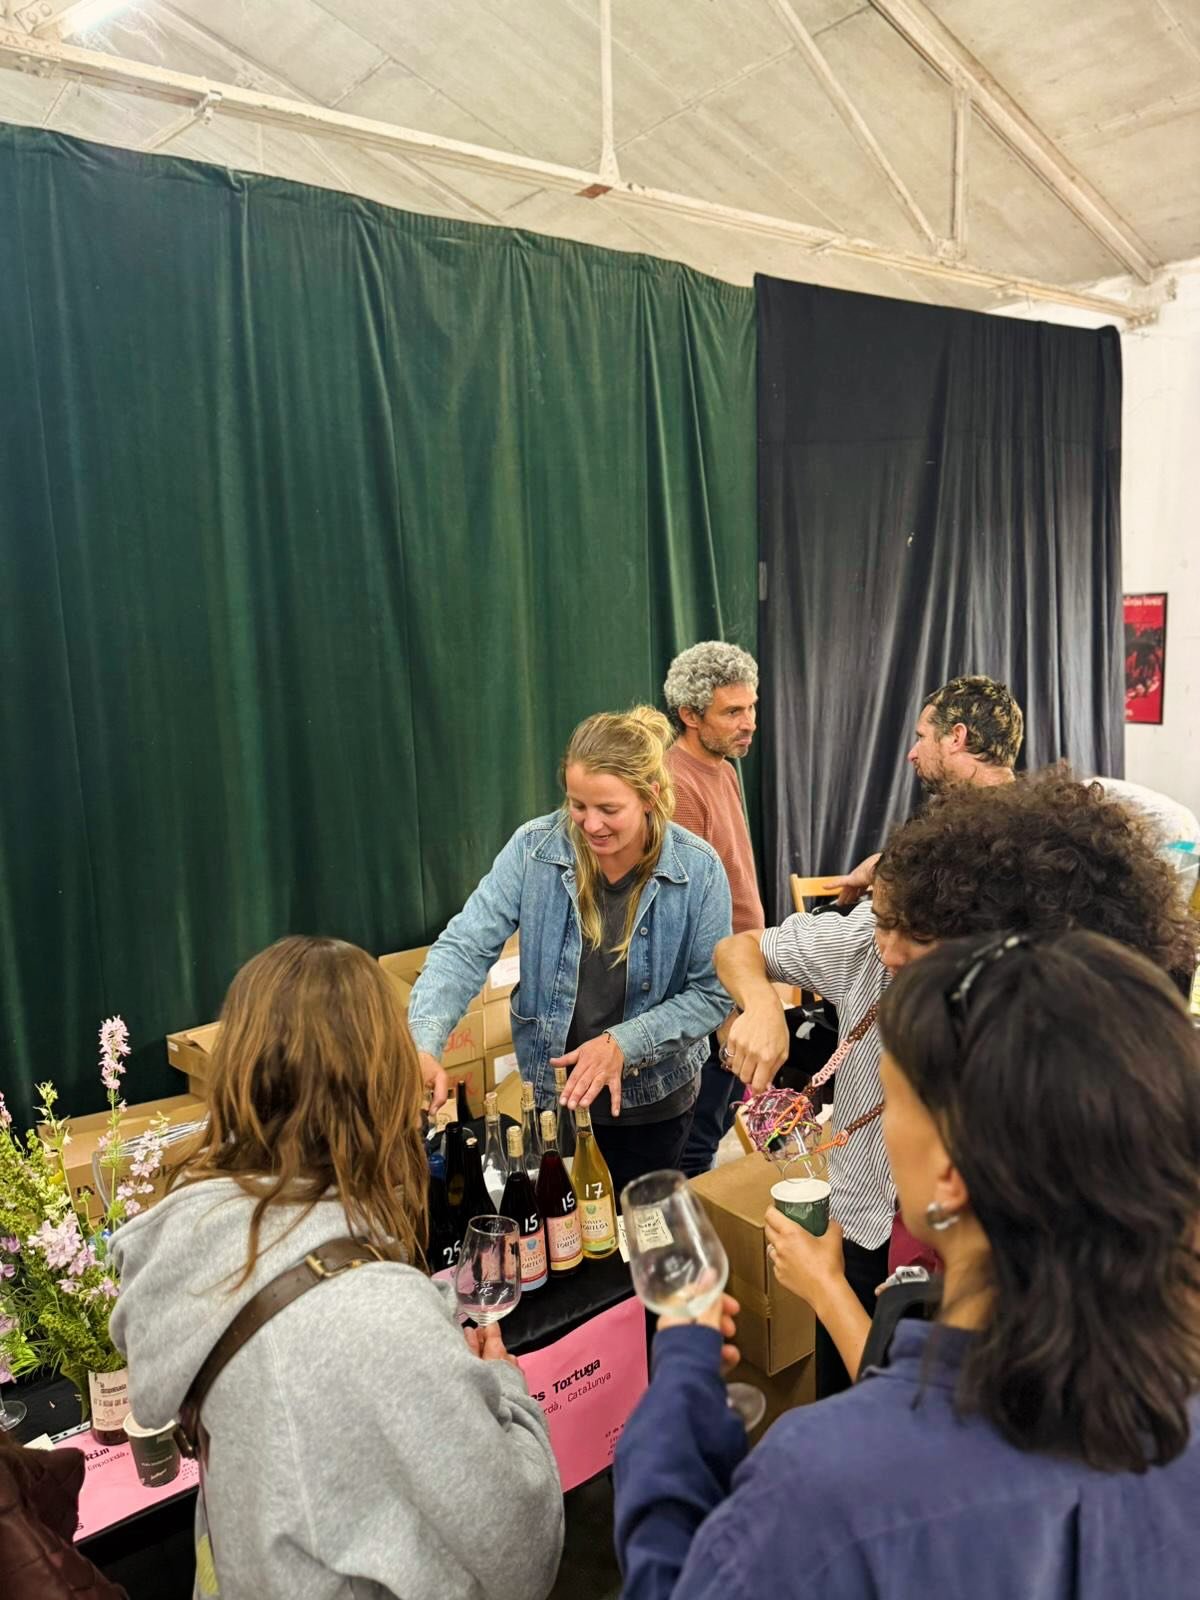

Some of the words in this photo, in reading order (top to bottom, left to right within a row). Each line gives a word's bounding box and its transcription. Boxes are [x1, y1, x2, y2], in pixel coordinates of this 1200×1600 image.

[585, 1181, 604, 1199] 17
[561, 1191, 576, 1212] 15
[524, 1213, 539, 1233] 15
[442, 1240, 461, 1264] 25
[552, 1359, 601, 1394] Tortuga
[567, 1372, 612, 1403] Catalunya
